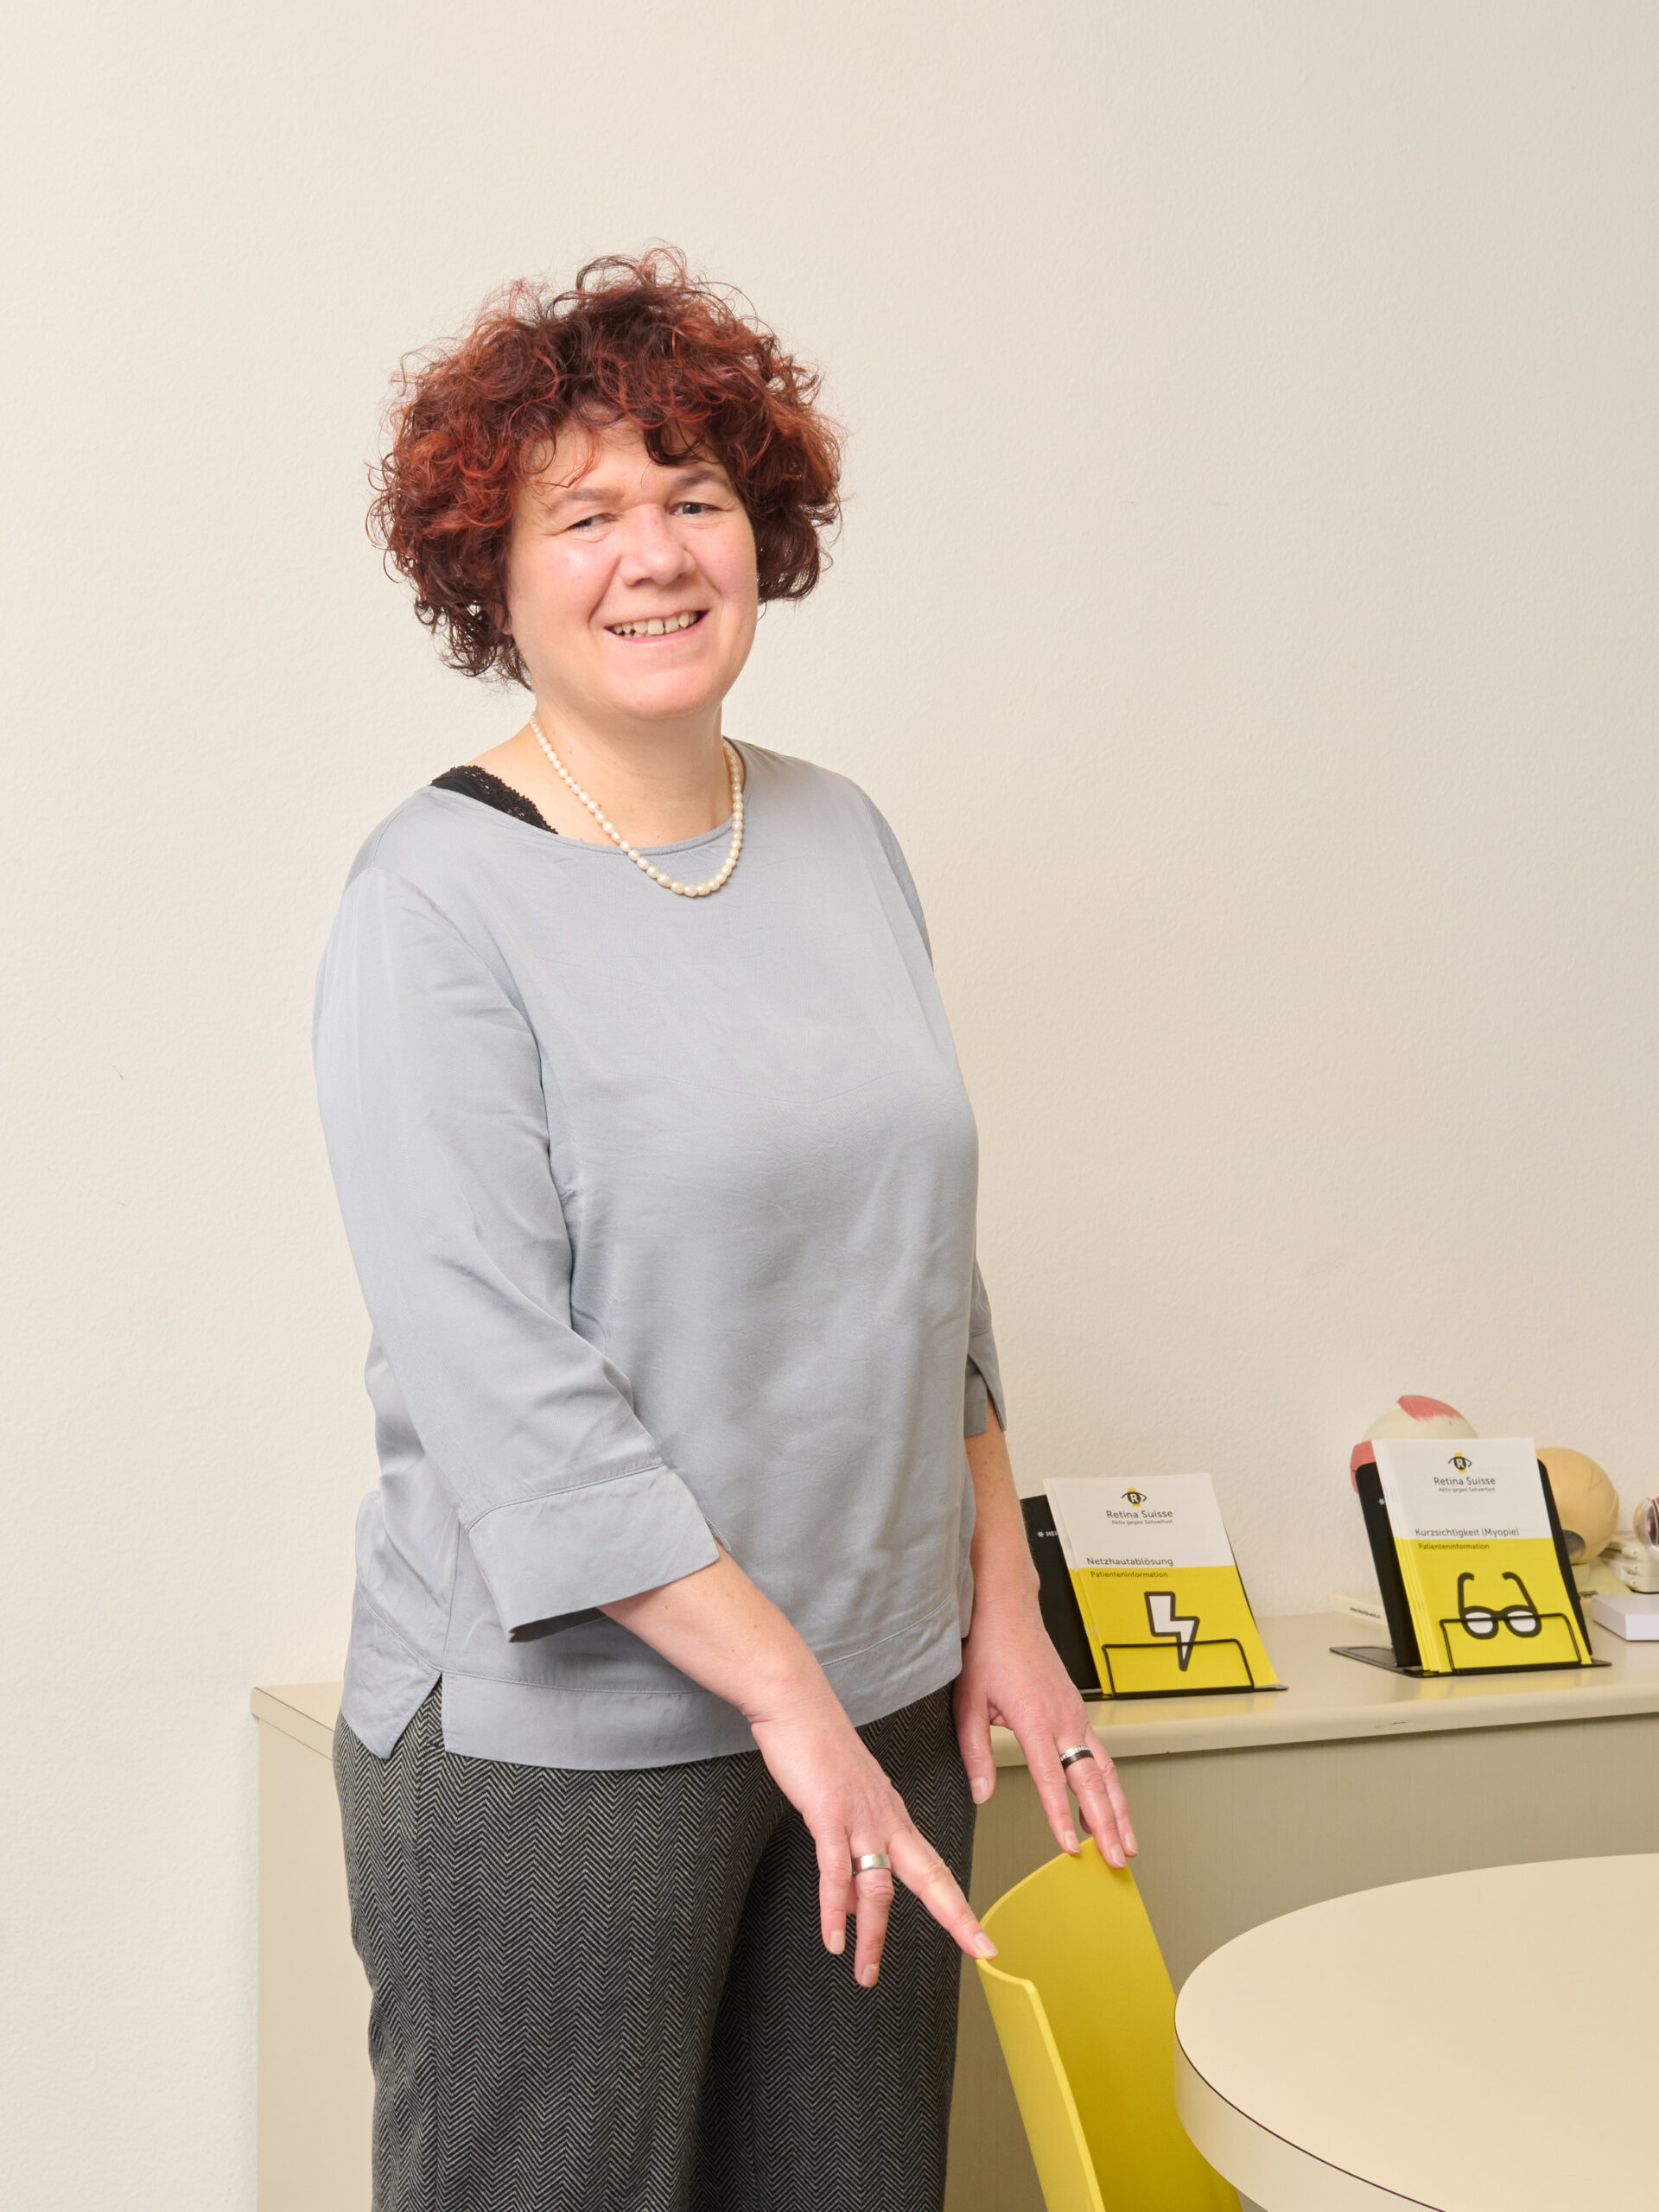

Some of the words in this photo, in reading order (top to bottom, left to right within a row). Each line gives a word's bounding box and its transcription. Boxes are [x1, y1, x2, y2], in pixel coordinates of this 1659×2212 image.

[1433, 1477, 1464, 1485] Retina
[1465, 1477, 1496, 1485] Suisse
[1106, 1510, 1139, 1519] Retina
[1141, 1510, 1173, 1518] Suisse
[1414, 1529, 1480, 1538] Kurzsichtigkeit
[1481, 1528, 1519, 1538] (Myopie)
[1086, 1558, 1173, 1567] Netzhautablösung
